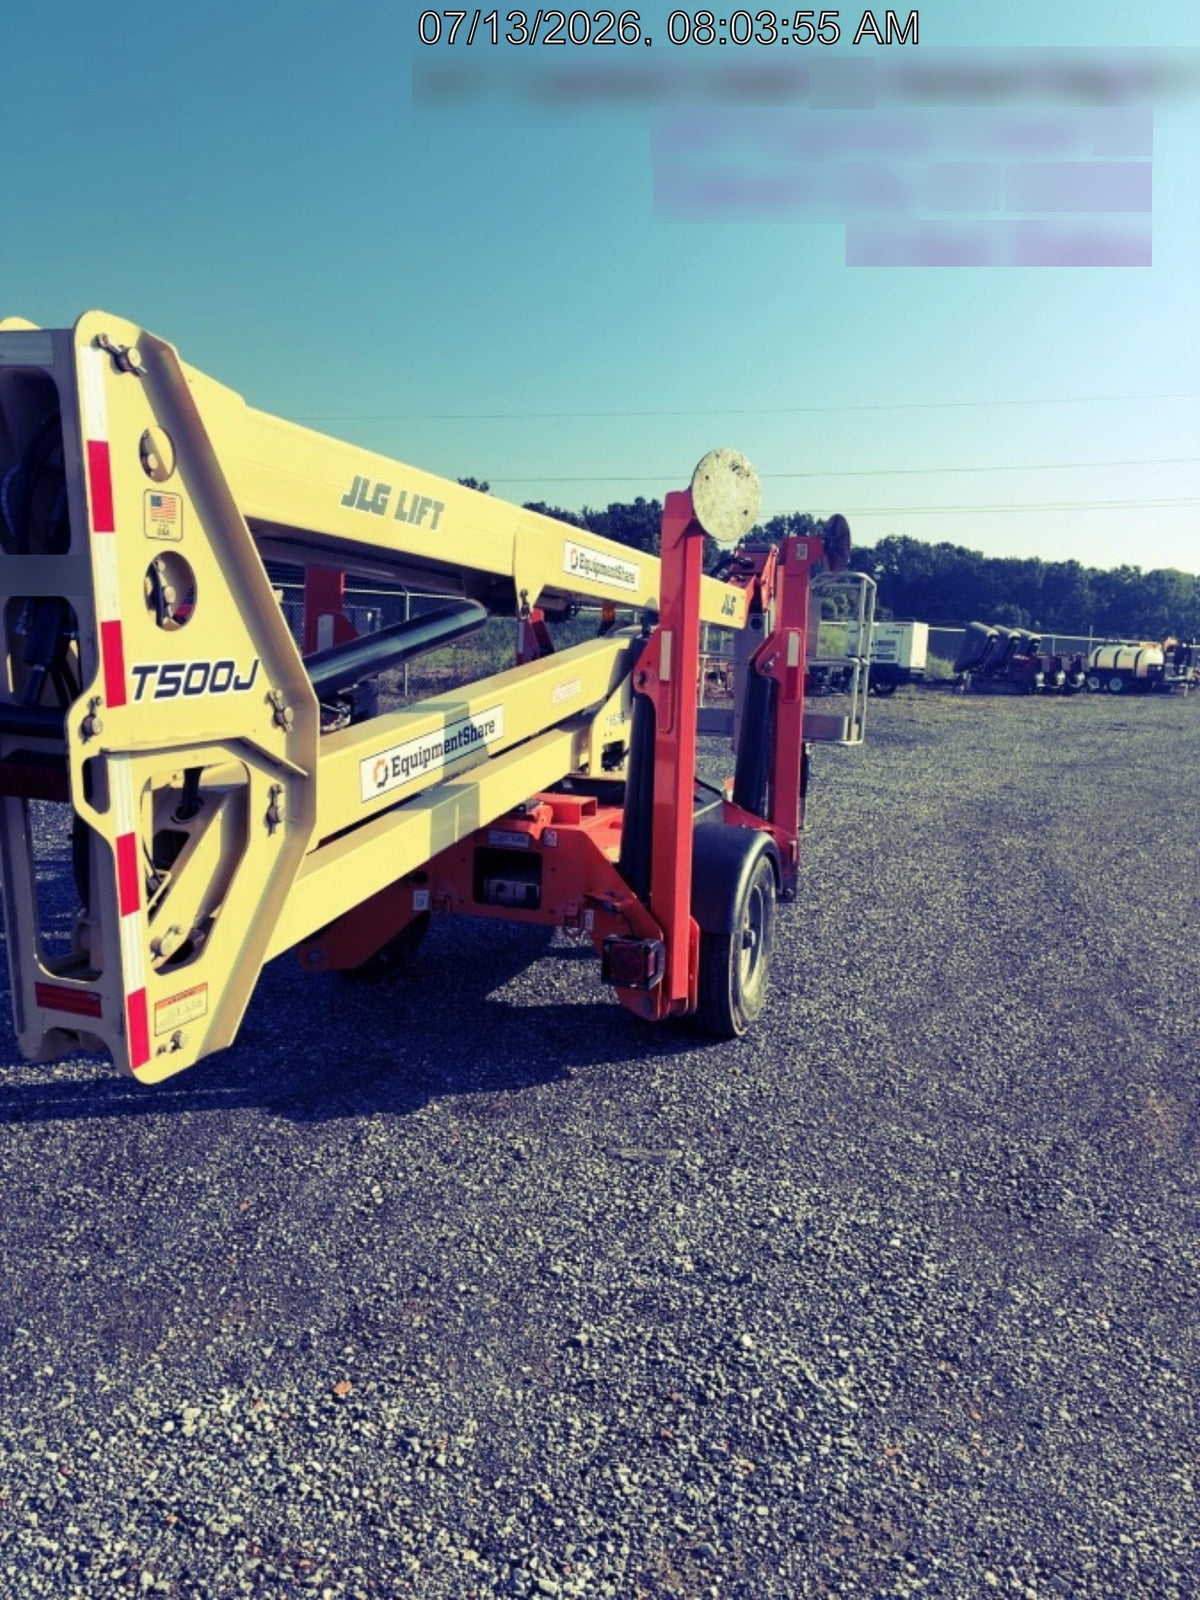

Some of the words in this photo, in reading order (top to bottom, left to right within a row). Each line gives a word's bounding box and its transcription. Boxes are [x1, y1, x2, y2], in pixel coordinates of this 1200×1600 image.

[341, 475, 391, 516] JLG
[394, 490, 445, 530] LIFT
[579, 553, 636, 585] EquipmentShare
[131, 659, 260, 701] T500J
[391, 719, 496, 778] EquipmentShare
